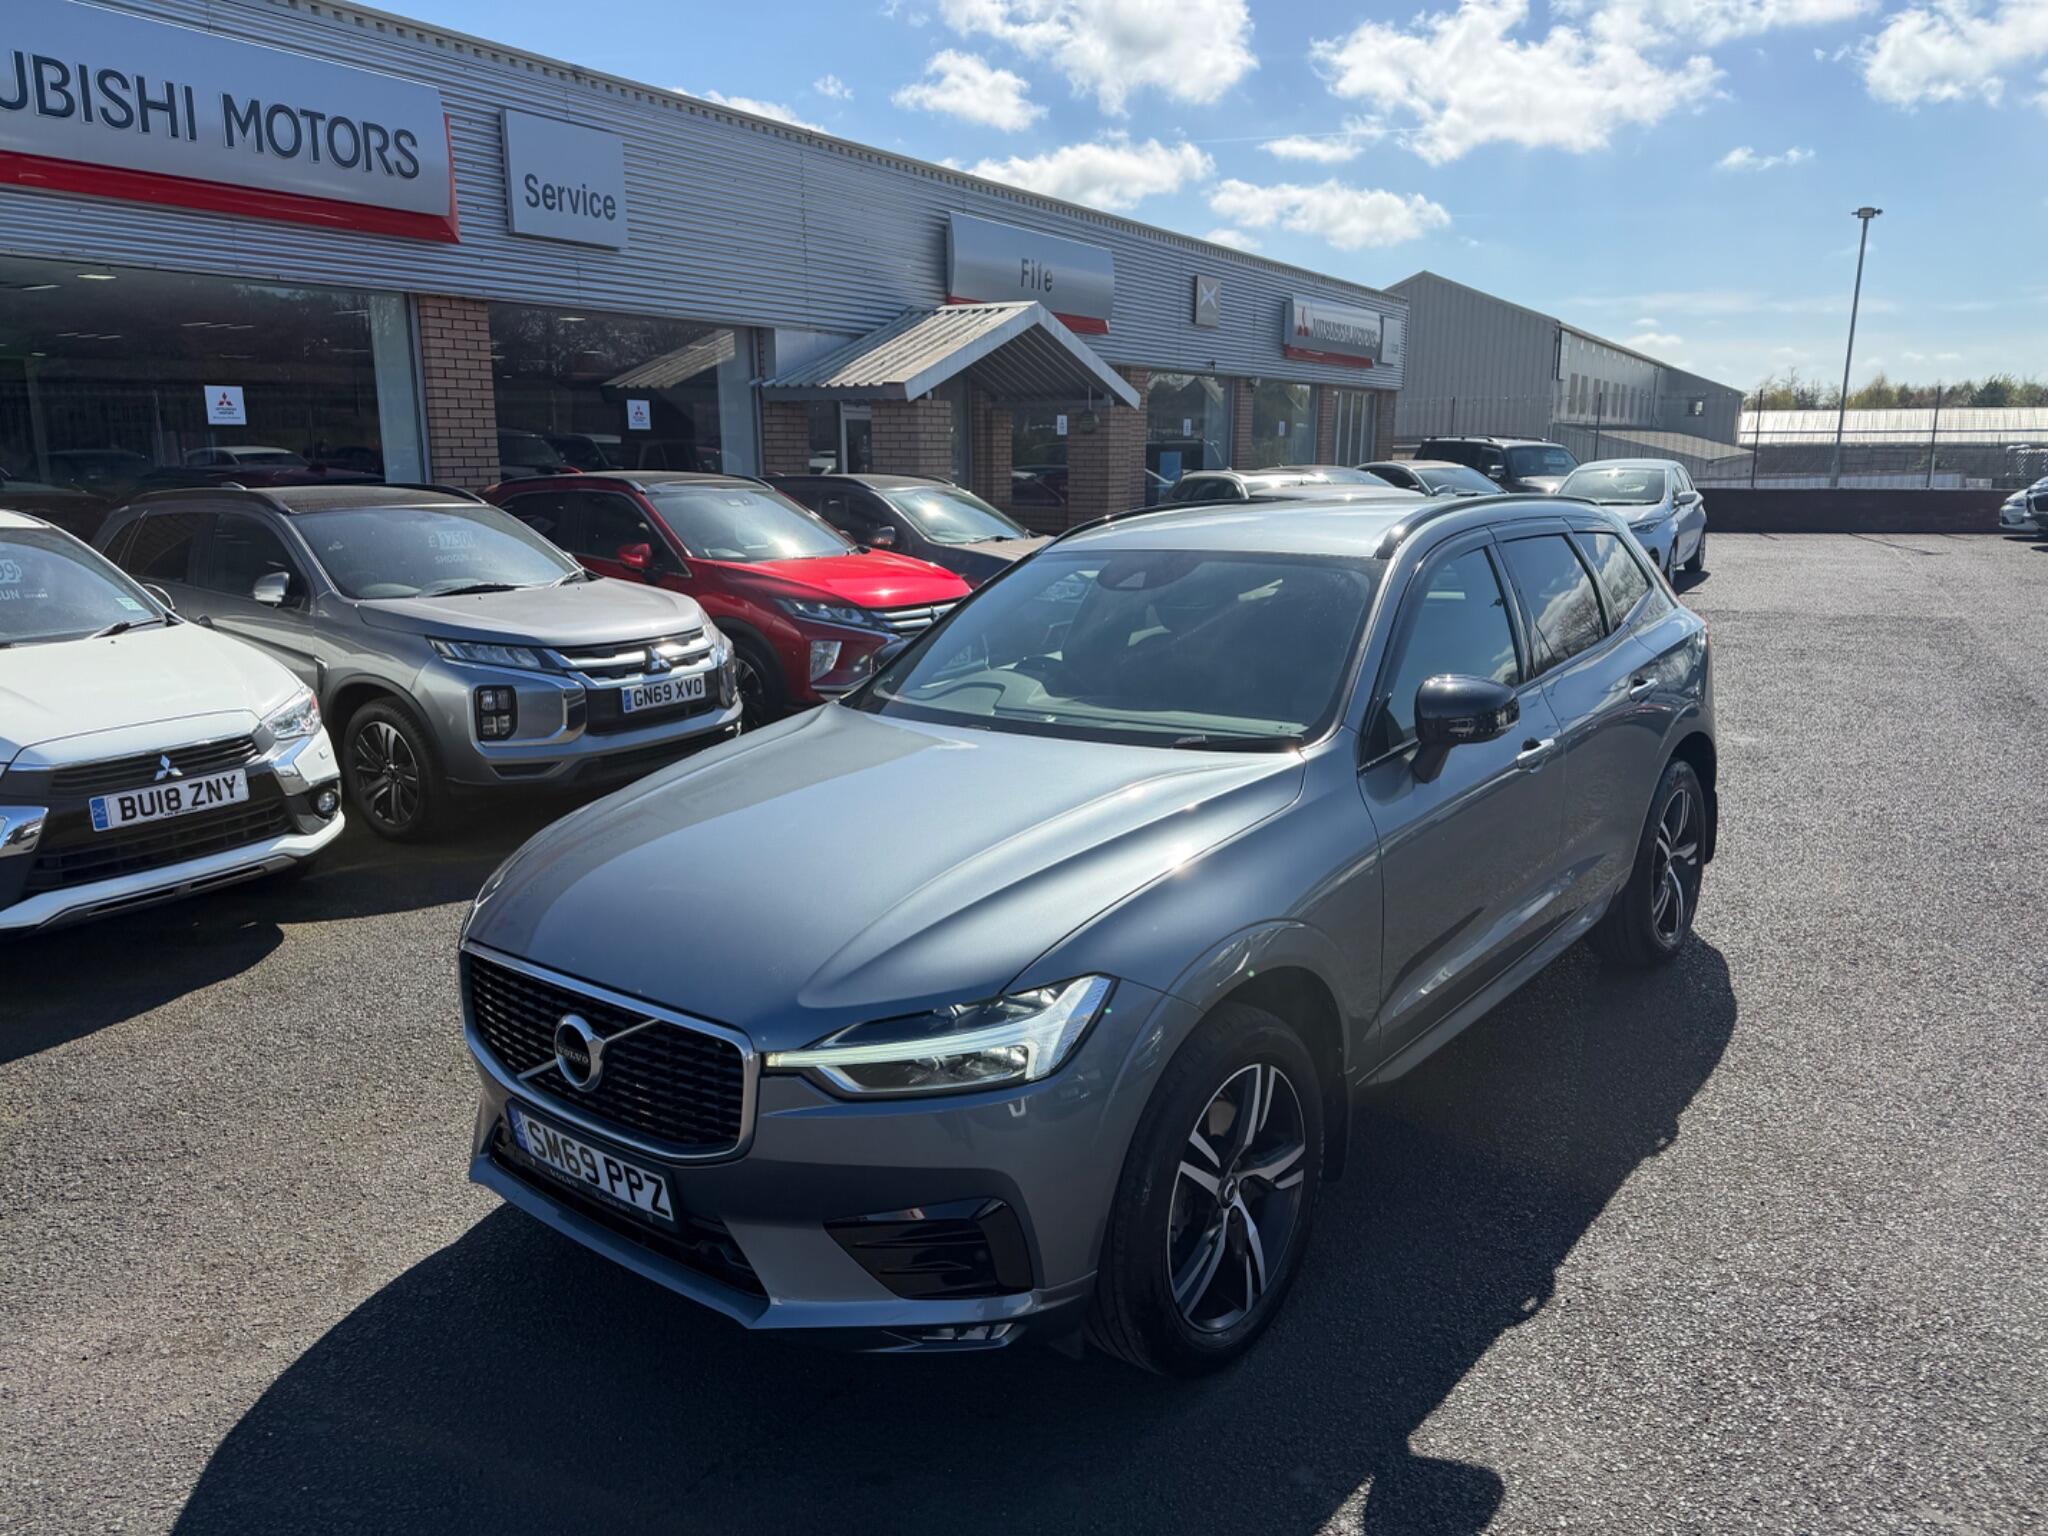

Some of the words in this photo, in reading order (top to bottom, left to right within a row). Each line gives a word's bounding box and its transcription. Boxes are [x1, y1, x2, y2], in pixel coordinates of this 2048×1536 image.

[220, 93, 420, 179] MOTORS
[524, 173, 616, 221] Service
[633, 684, 672, 707] GN69
[675, 678, 702, 699] XVO
[118, 788, 182, 821] BU18
[188, 774, 236, 807] ZNY
[558, 1045, 589, 1065] VOLVO
[527, 1120, 600, 1185] SM69
[603, 1156, 670, 1217] PPZ
